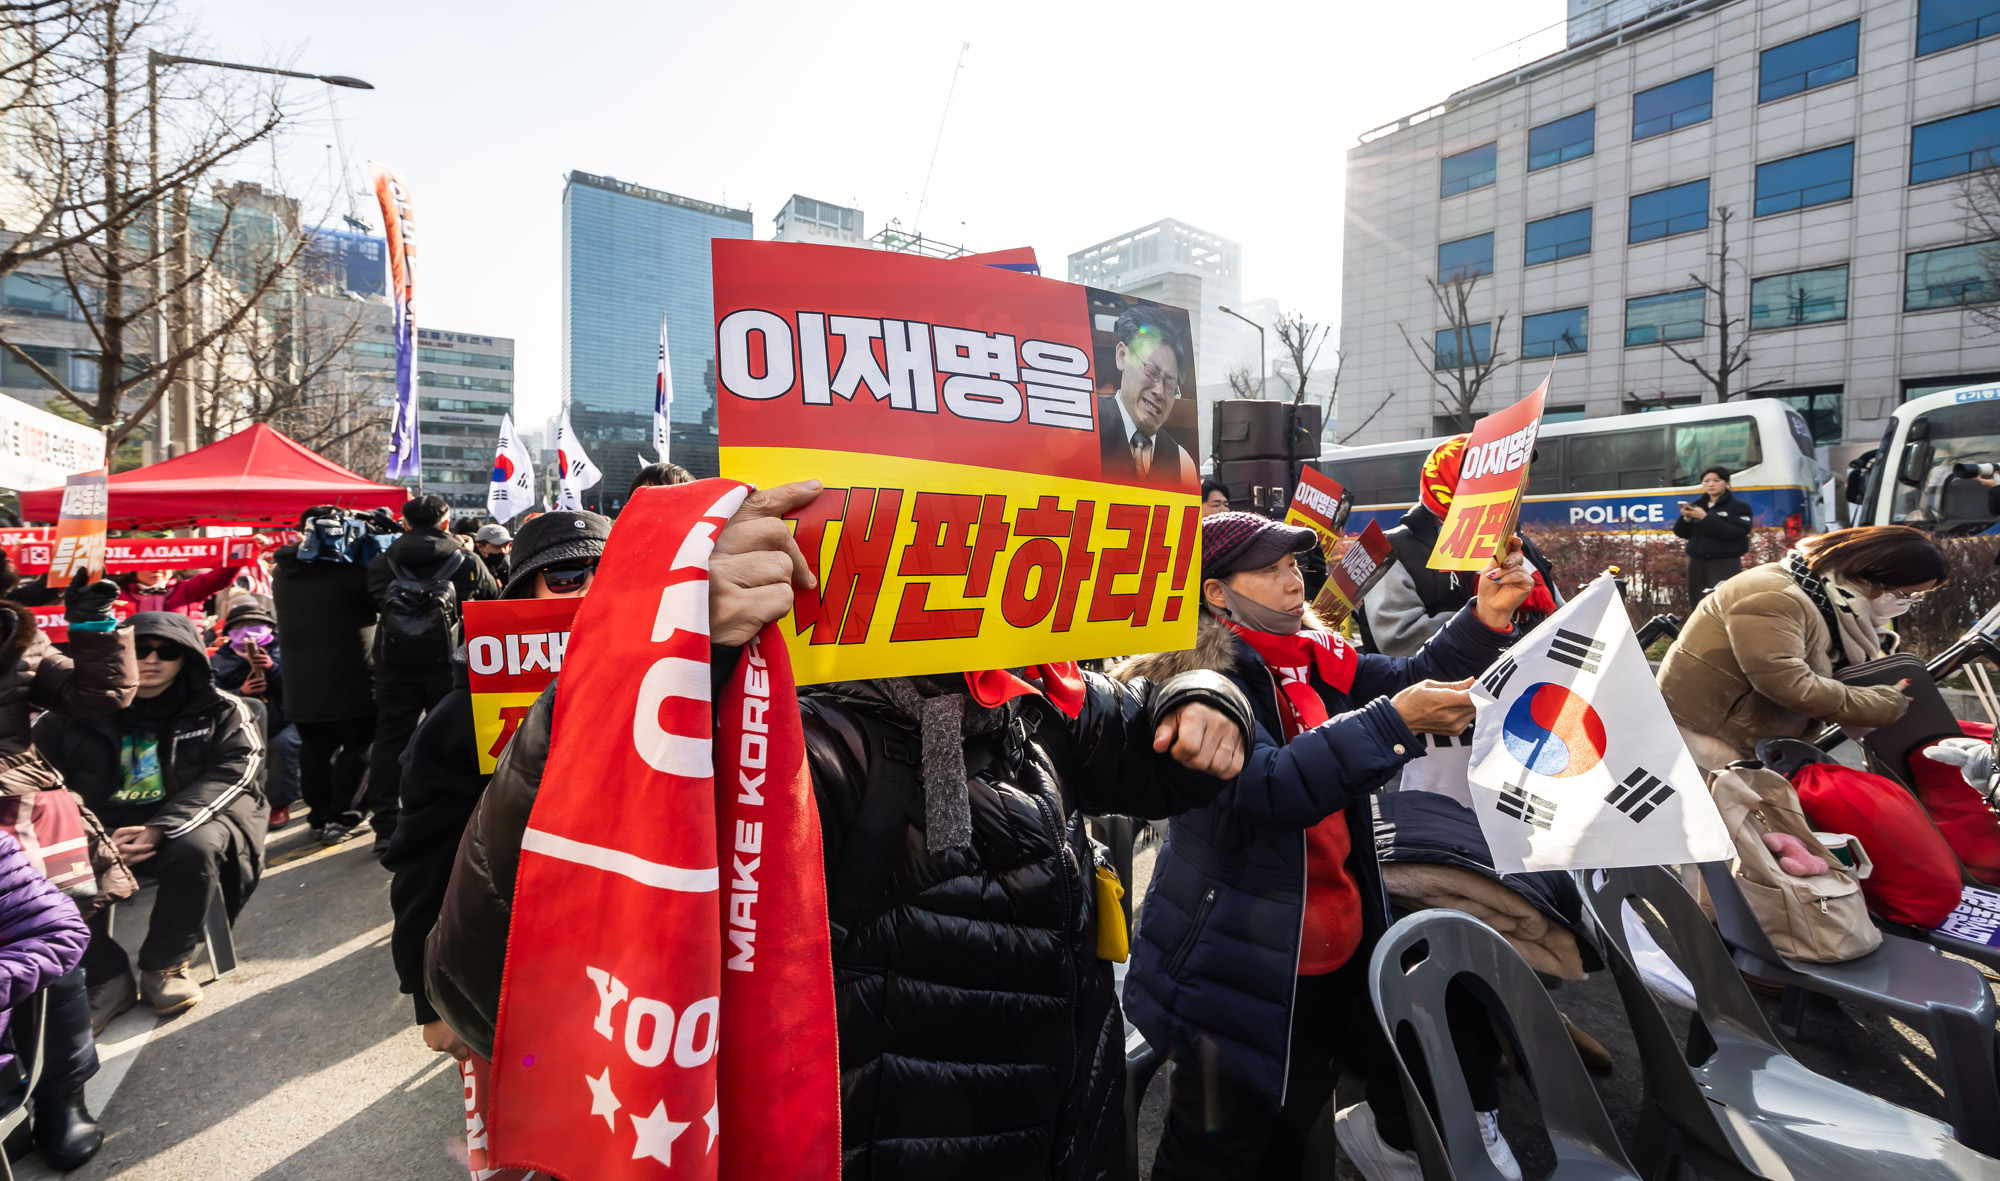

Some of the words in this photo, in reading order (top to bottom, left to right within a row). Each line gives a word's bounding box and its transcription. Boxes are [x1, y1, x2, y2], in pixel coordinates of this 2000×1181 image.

[718, 308, 1095, 431] 이재명을
[1958, 389, 2000, 400] 4기동
[1461, 417, 1539, 480] 이재명을
[1295, 481, 1338, 519] 이재명을
[1440, 500, 1513, 558] 재판
[1569, 503, 1663, 525] POLICE
[781, 486, 1200, 645] 재판하라!
[1341, 541, 1377, 586] 이재명을
[737, 635, 770, 806] KOREA
[727, 819, 764, 972] MAKE
[586, 965, 719, 1069] YOO
